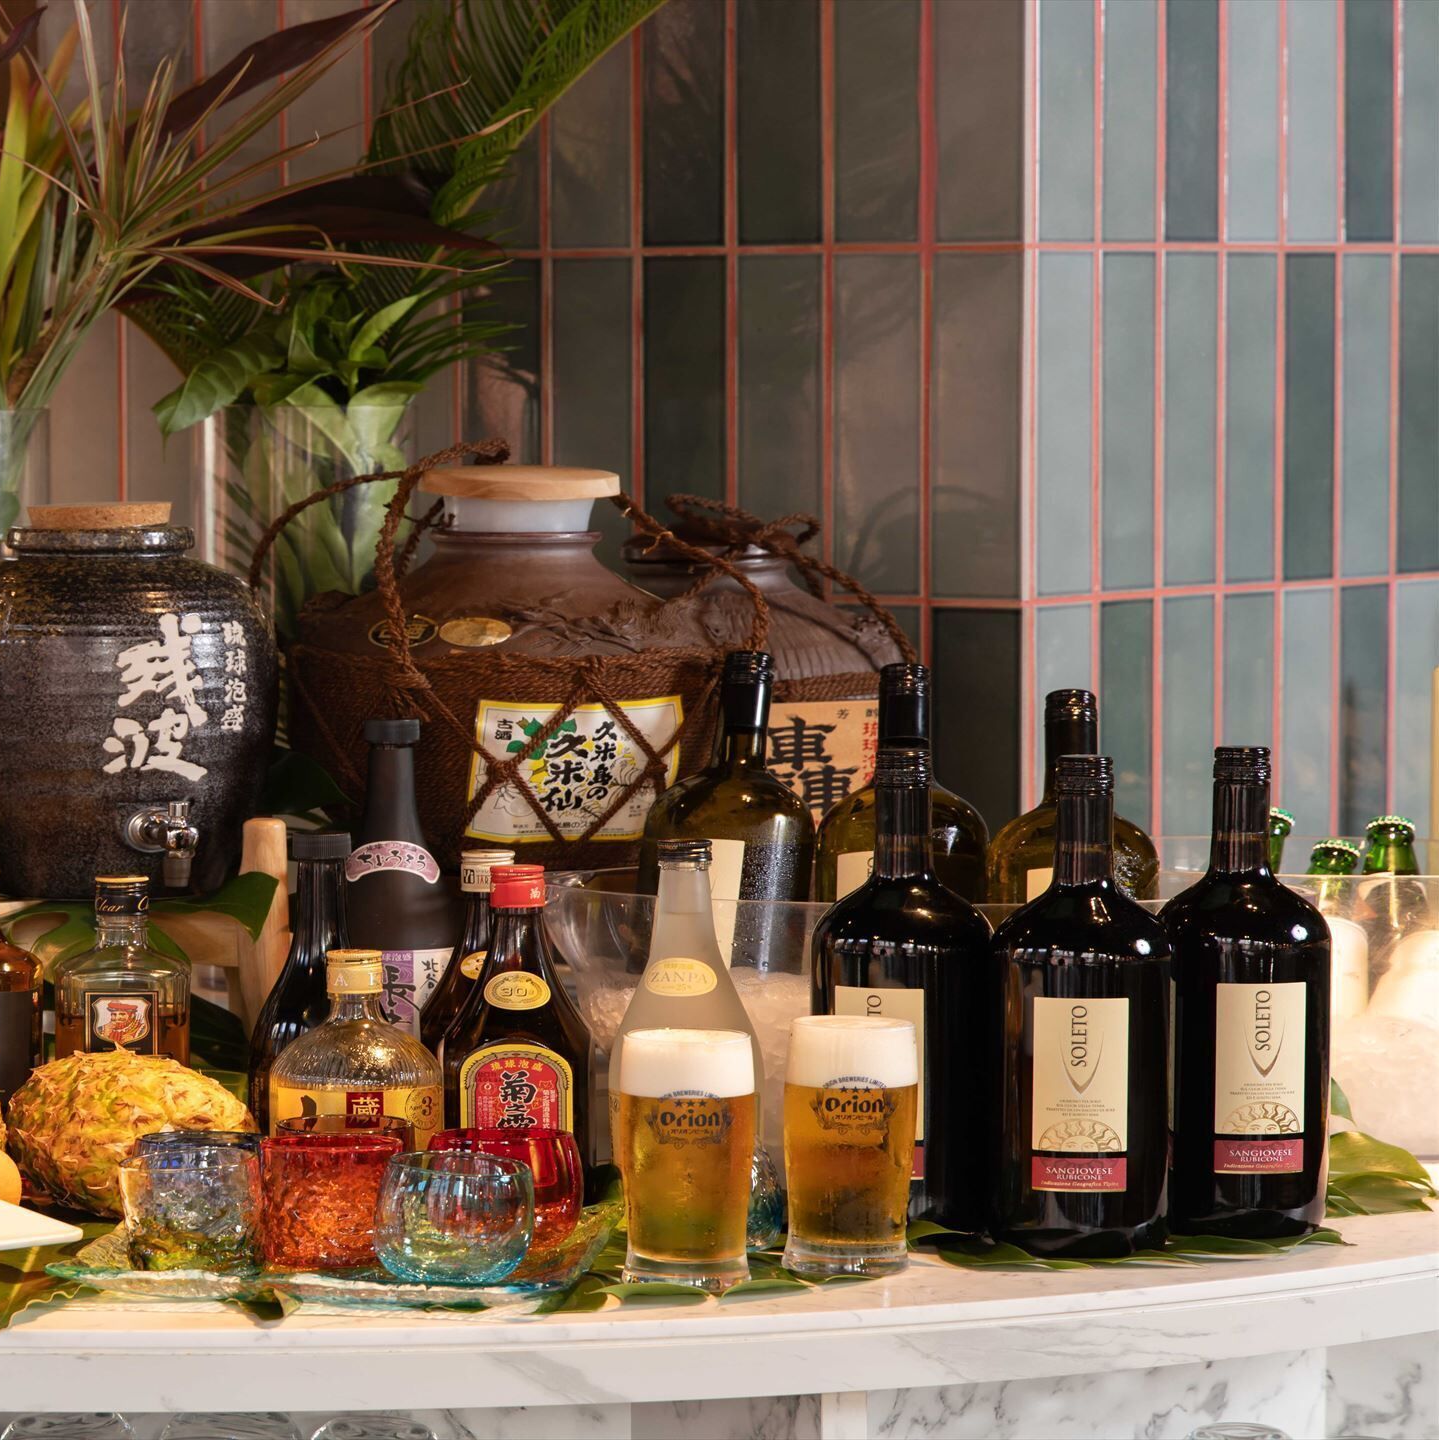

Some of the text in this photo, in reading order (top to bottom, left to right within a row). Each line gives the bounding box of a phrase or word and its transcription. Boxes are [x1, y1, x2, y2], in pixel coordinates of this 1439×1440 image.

[220, 620, 248, 731] 琉球泡盛
[495, 718, 514, 741] 古酒
[587, 721, 617, 800] 久米島の
[539, 733, 589, 812] 久米仙
[650, 971, 708, 984] ZANPA
[1255, 989, 1271, 1051] SOLETO
[1071, 1005, 1087, 1067] SOLETO
[422, 1096, 433, 1116] 3
[825, 1095, 885, 1113] Orion
[660, 1109, 720, 1127] Orion
[1229, 1149, 1293, 1157] SANGIOVESE
[1045, 1166, 1113, 1175] SANGIOVESE
[1056, 1173, 1104, 1181] RUBICONE
